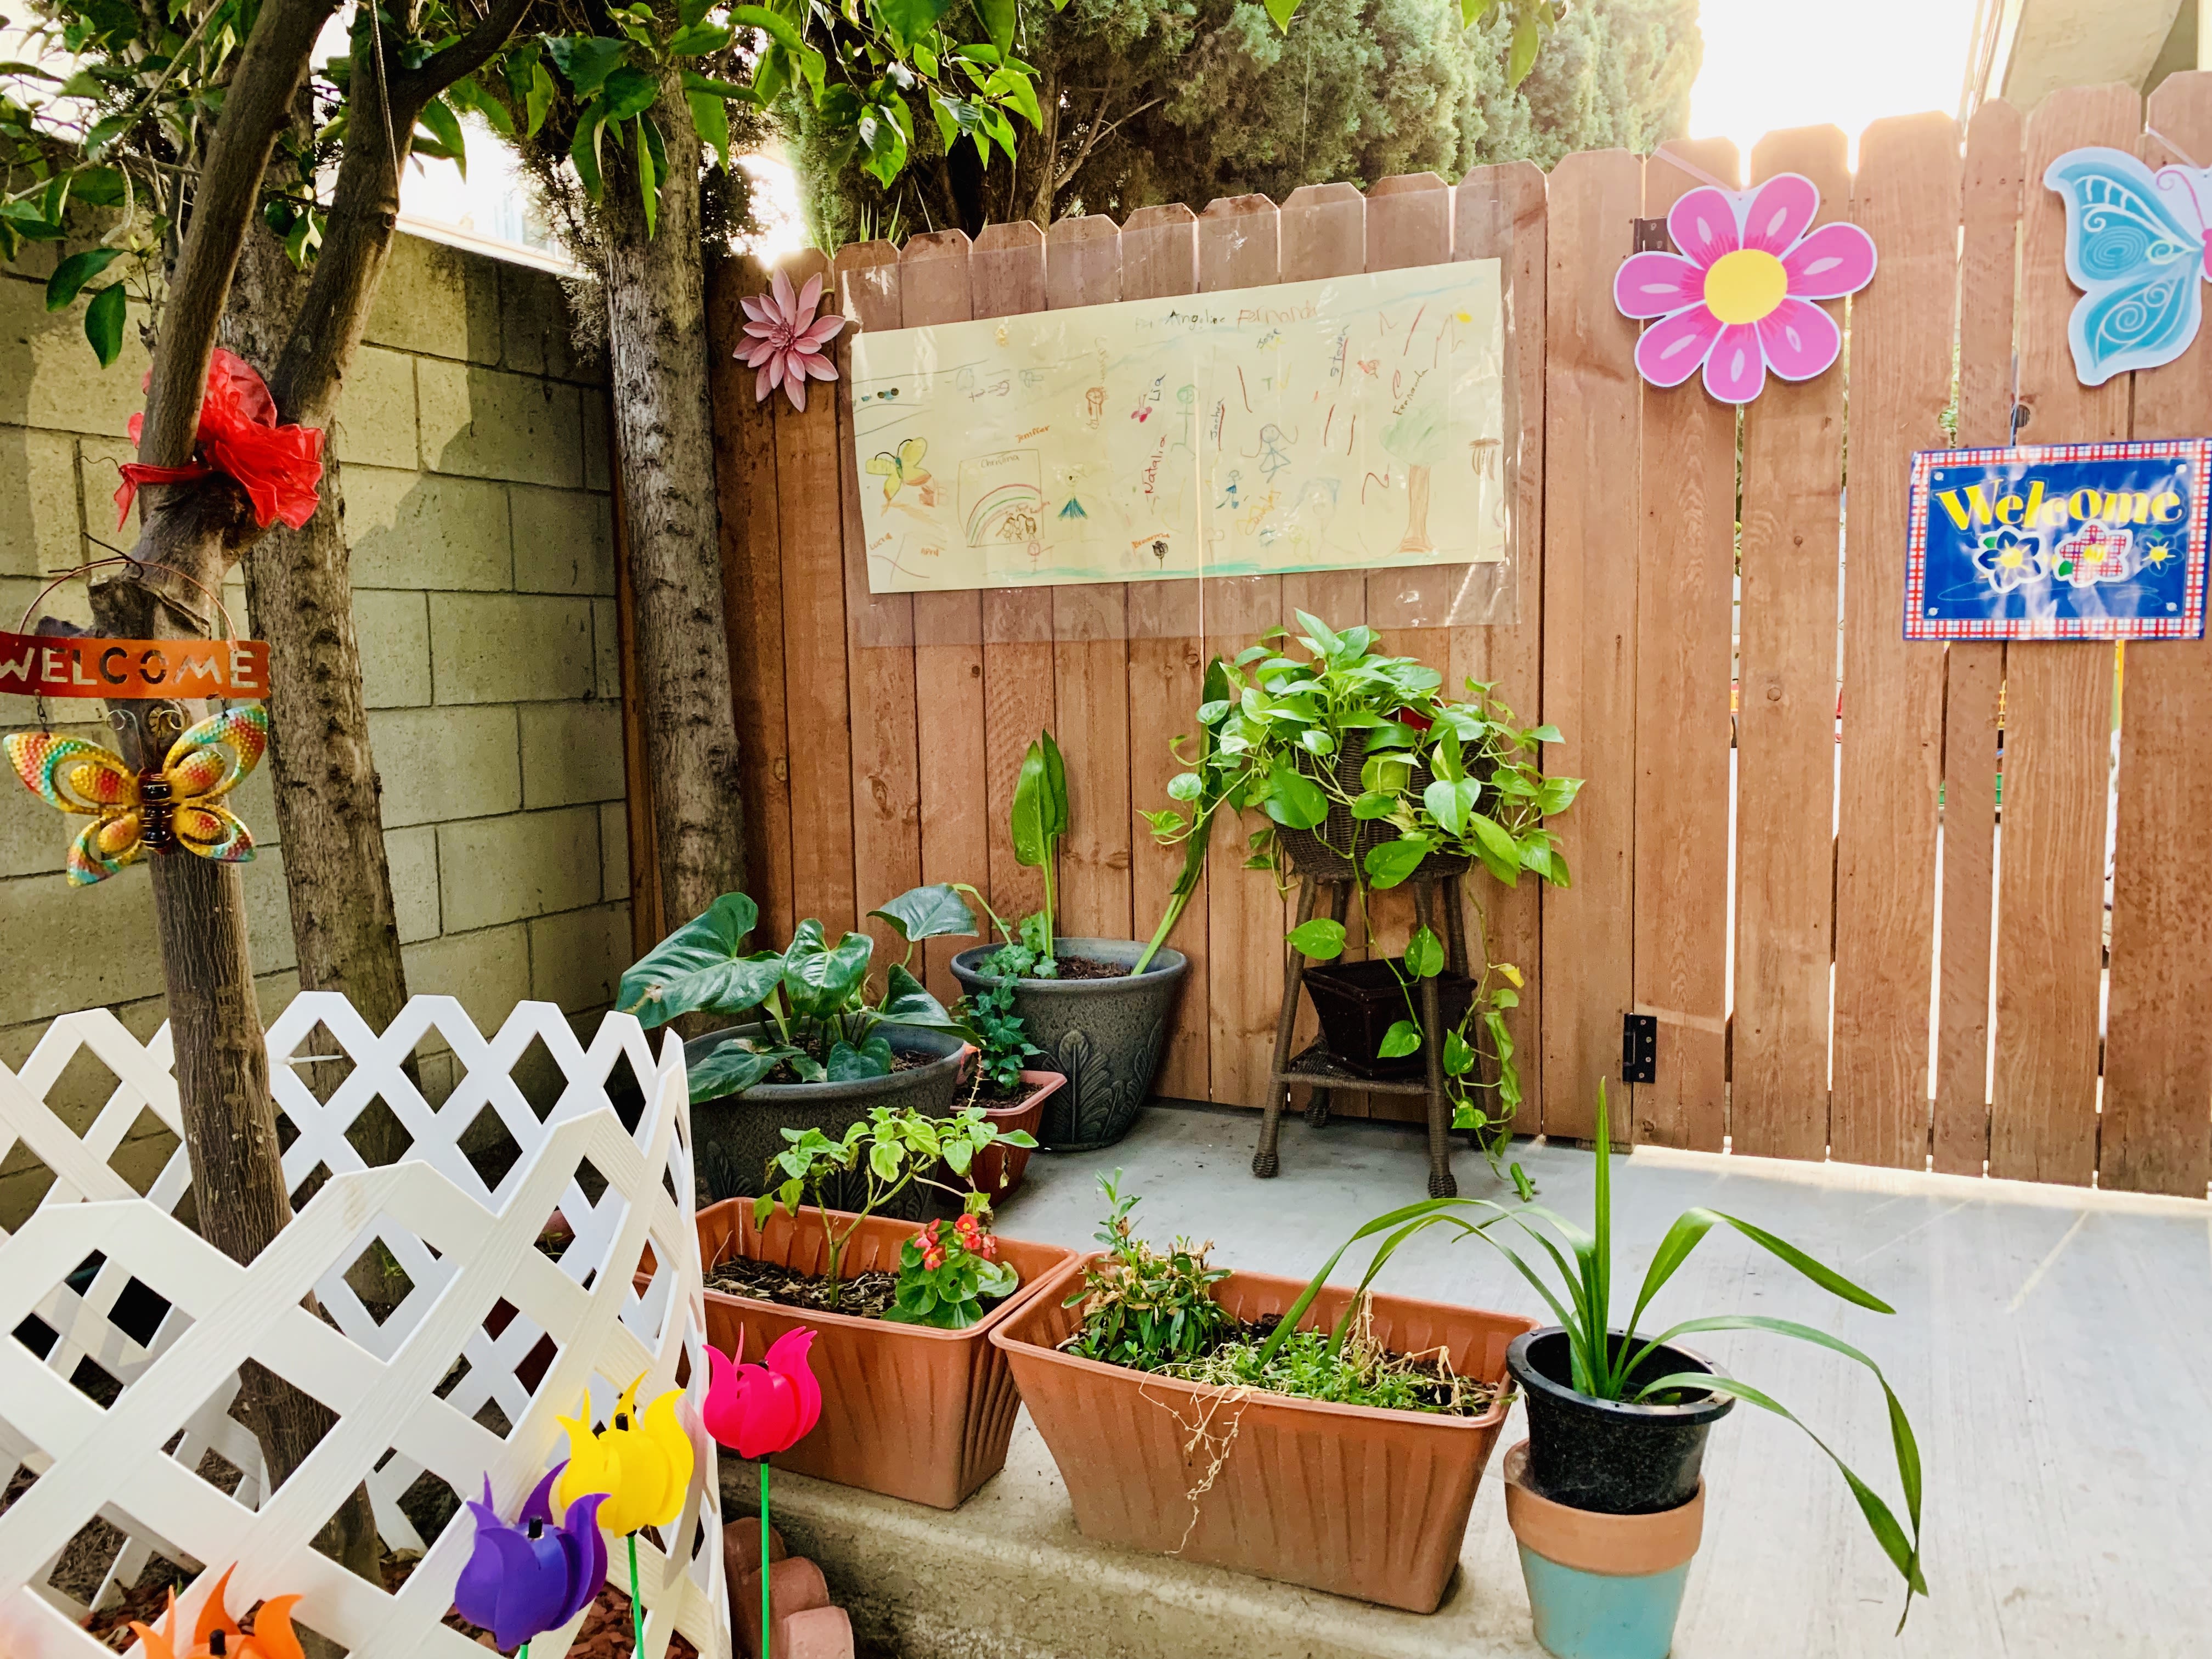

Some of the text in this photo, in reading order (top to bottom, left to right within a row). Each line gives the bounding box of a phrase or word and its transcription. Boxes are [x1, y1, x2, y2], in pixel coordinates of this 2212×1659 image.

[1149, 373, 1166, 402] Lia
[1144, 435, 1167, 494] Natalia
[1936, 478, 2183, 531] Welcome
[0, 646, 258, 689] WELCOME
